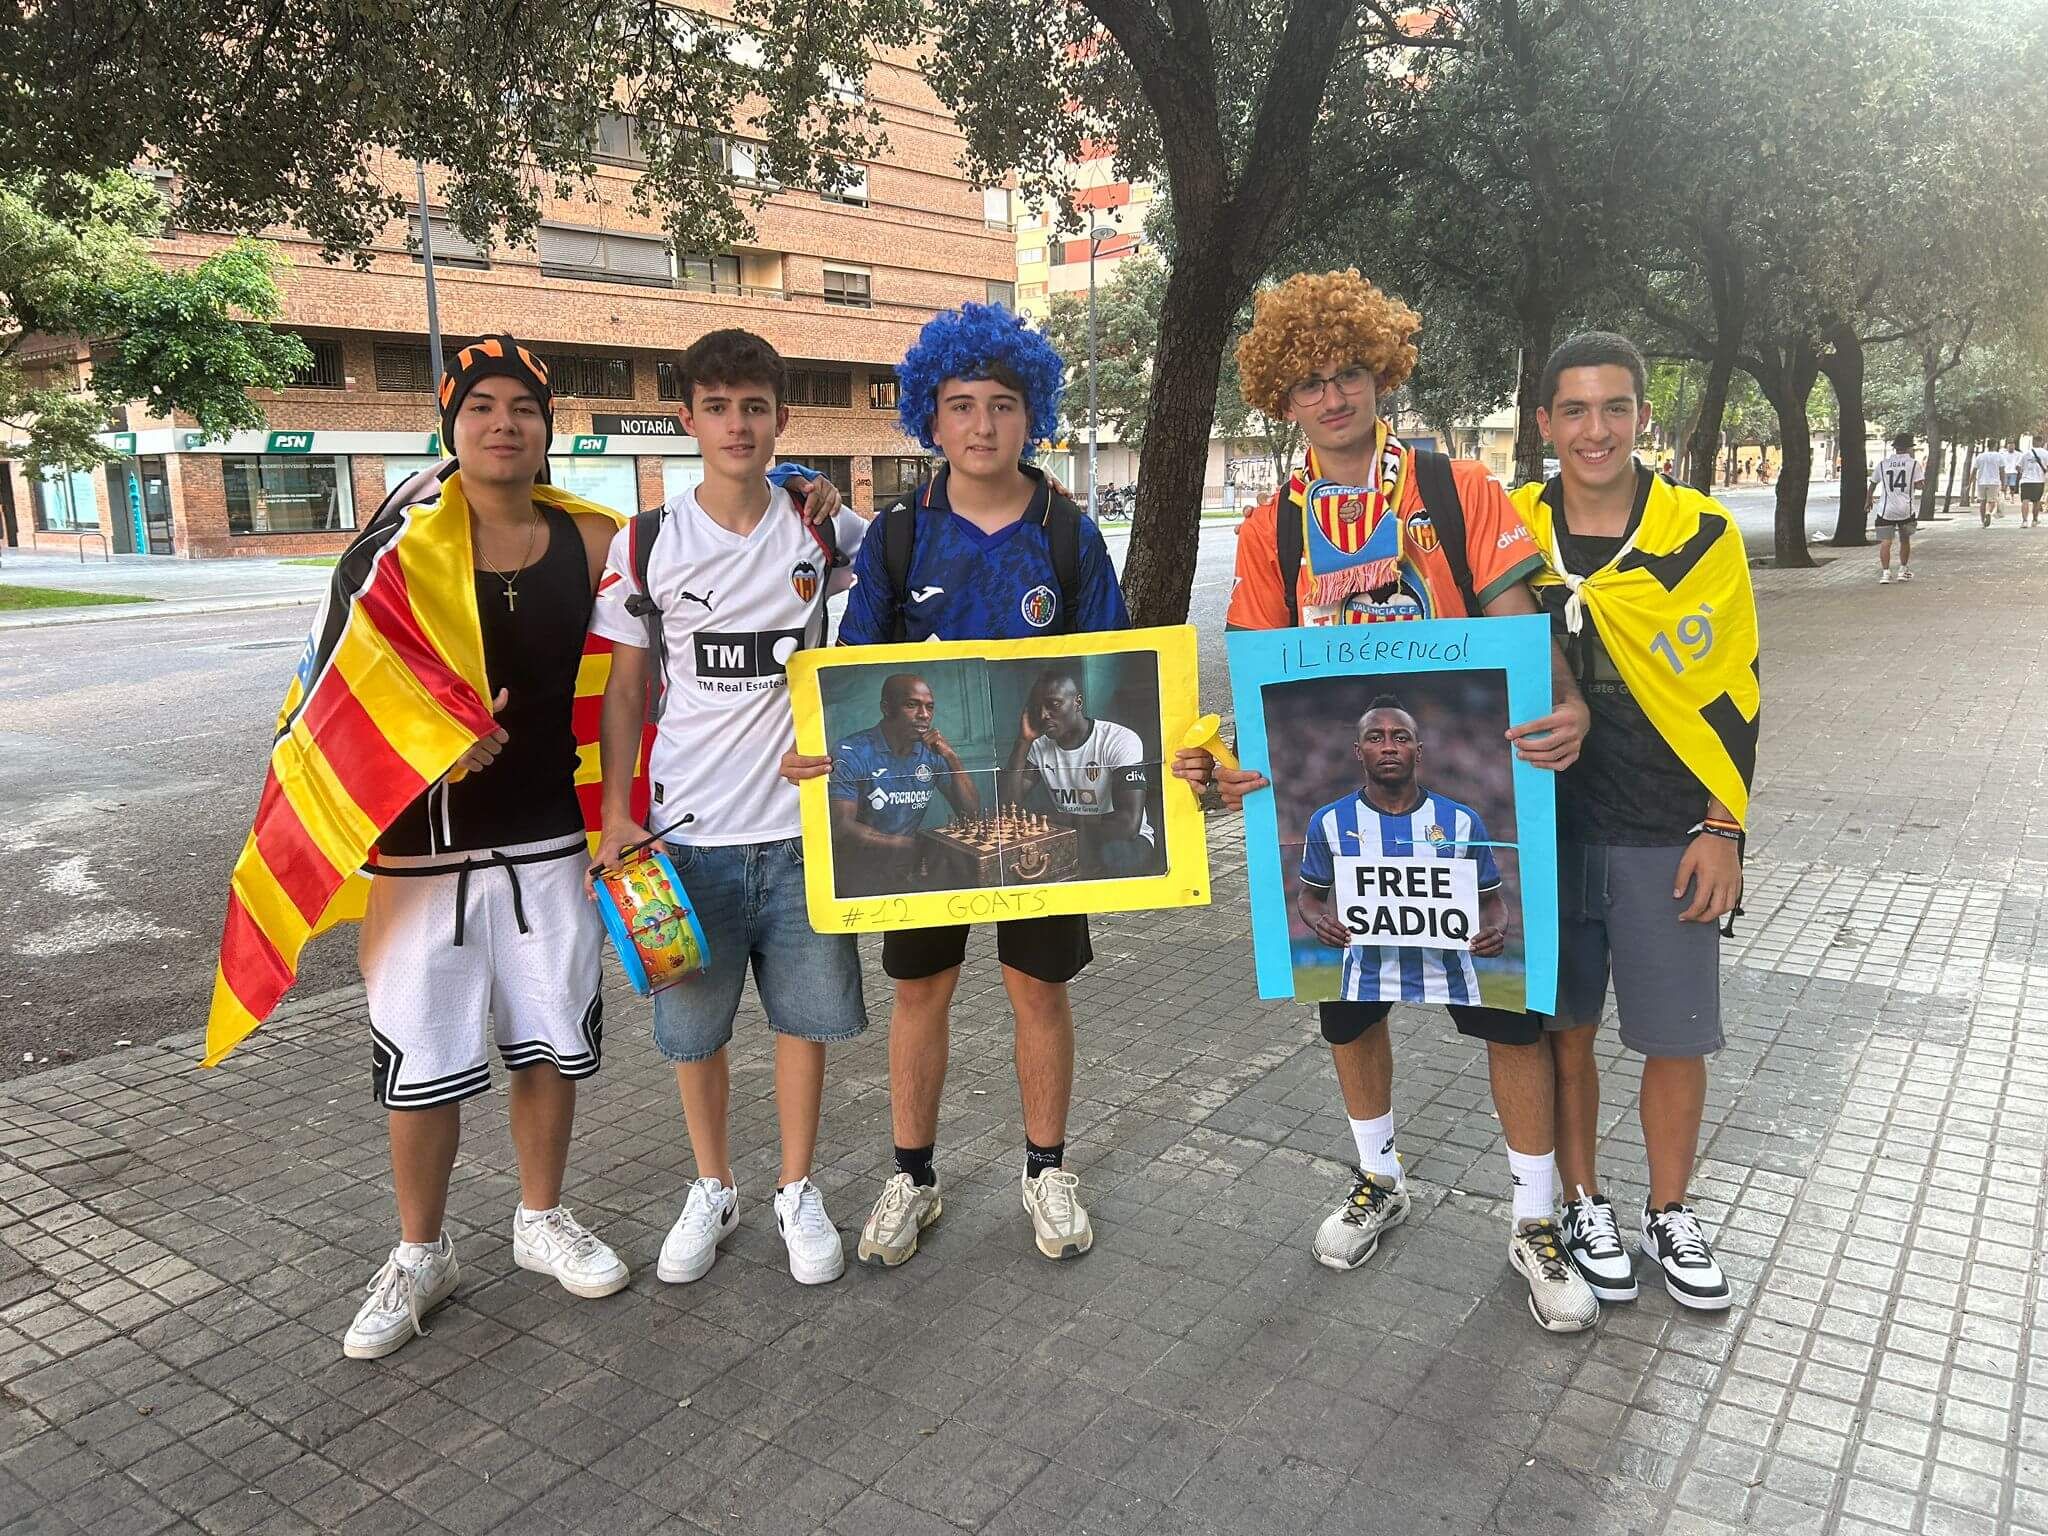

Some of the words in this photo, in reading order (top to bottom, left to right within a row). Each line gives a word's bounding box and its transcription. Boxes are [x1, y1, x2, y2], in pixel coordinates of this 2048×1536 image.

[620, 417, 676, 434] NOTARÍA
[275, 434, 308, 449] PSN
[578, 438, 603, 450] PSN
[1886, 469, 1907, 493] 14
[702, 644, 745, 669] TM
[697, 680, 714, 691] TM
[717, 682, 743, 692] Real
[1356, 866, 1453, 899] FREE
[947, 889, 1049, 919] GOATS
[1346, 905, 1470, 942] SADIQ
